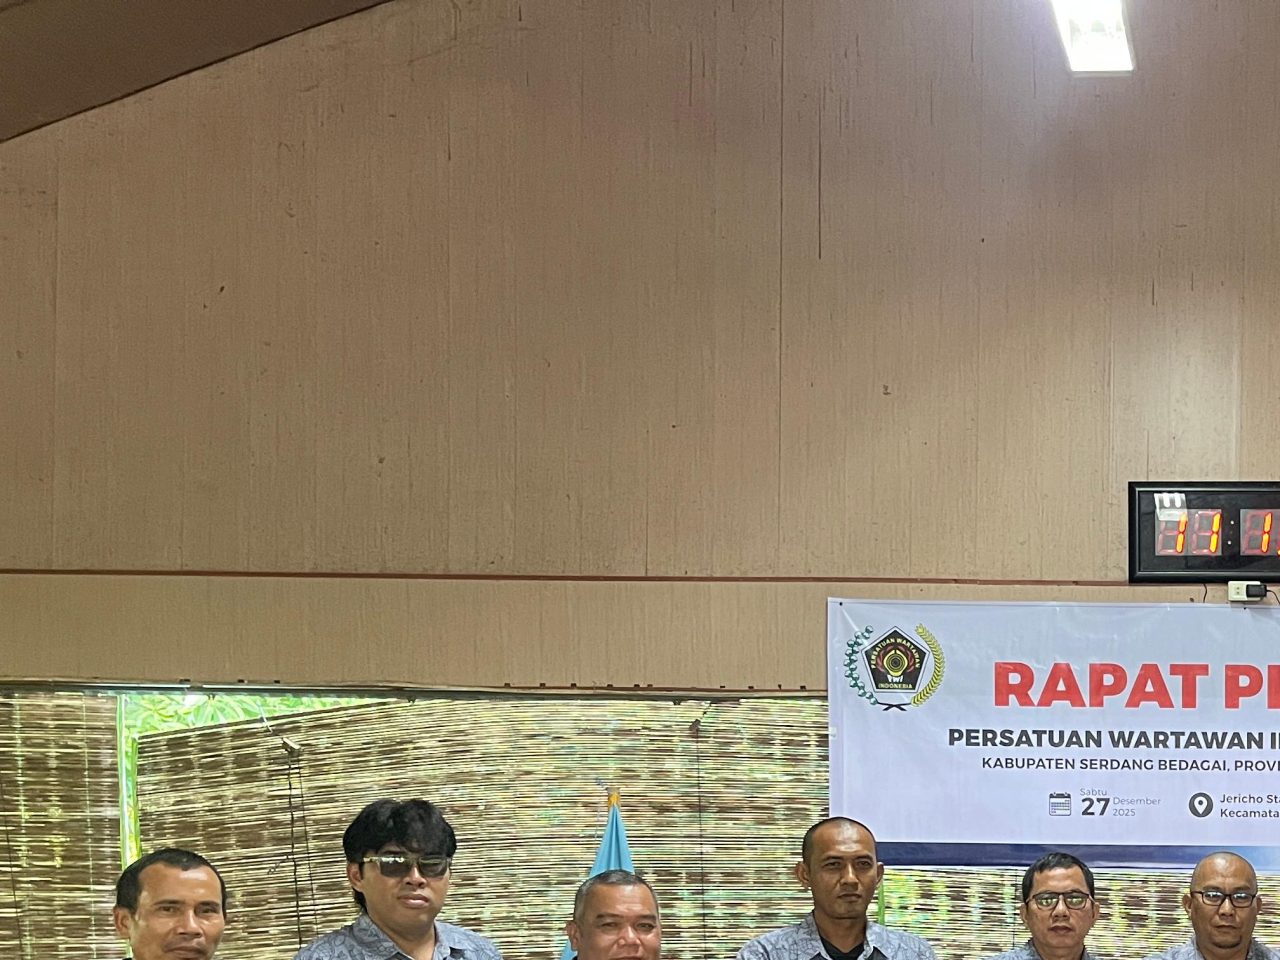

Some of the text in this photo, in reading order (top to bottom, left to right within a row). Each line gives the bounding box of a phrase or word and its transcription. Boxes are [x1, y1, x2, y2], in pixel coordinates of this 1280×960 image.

[994, 661, 1209, 709] RAPAT
[948, 728, 1102, 748] PERSATUAN
[1108, 730, 1263, 750] WARTAWAN
[982, 757, 1075, 770] KABUPATEN
[1079, 758, 1154, 771] SERDANG
[1158, 759, 1230, 773] BEDAGAI,
[1080, 787, 1108, 796] Sabtu
[1112, 796, 1161, 805] Desember
[1219, 793, 1263, 804] Jericho
[1081, 797, 1111, 816] 27
[1112, 808, 1136, 817] 2025
